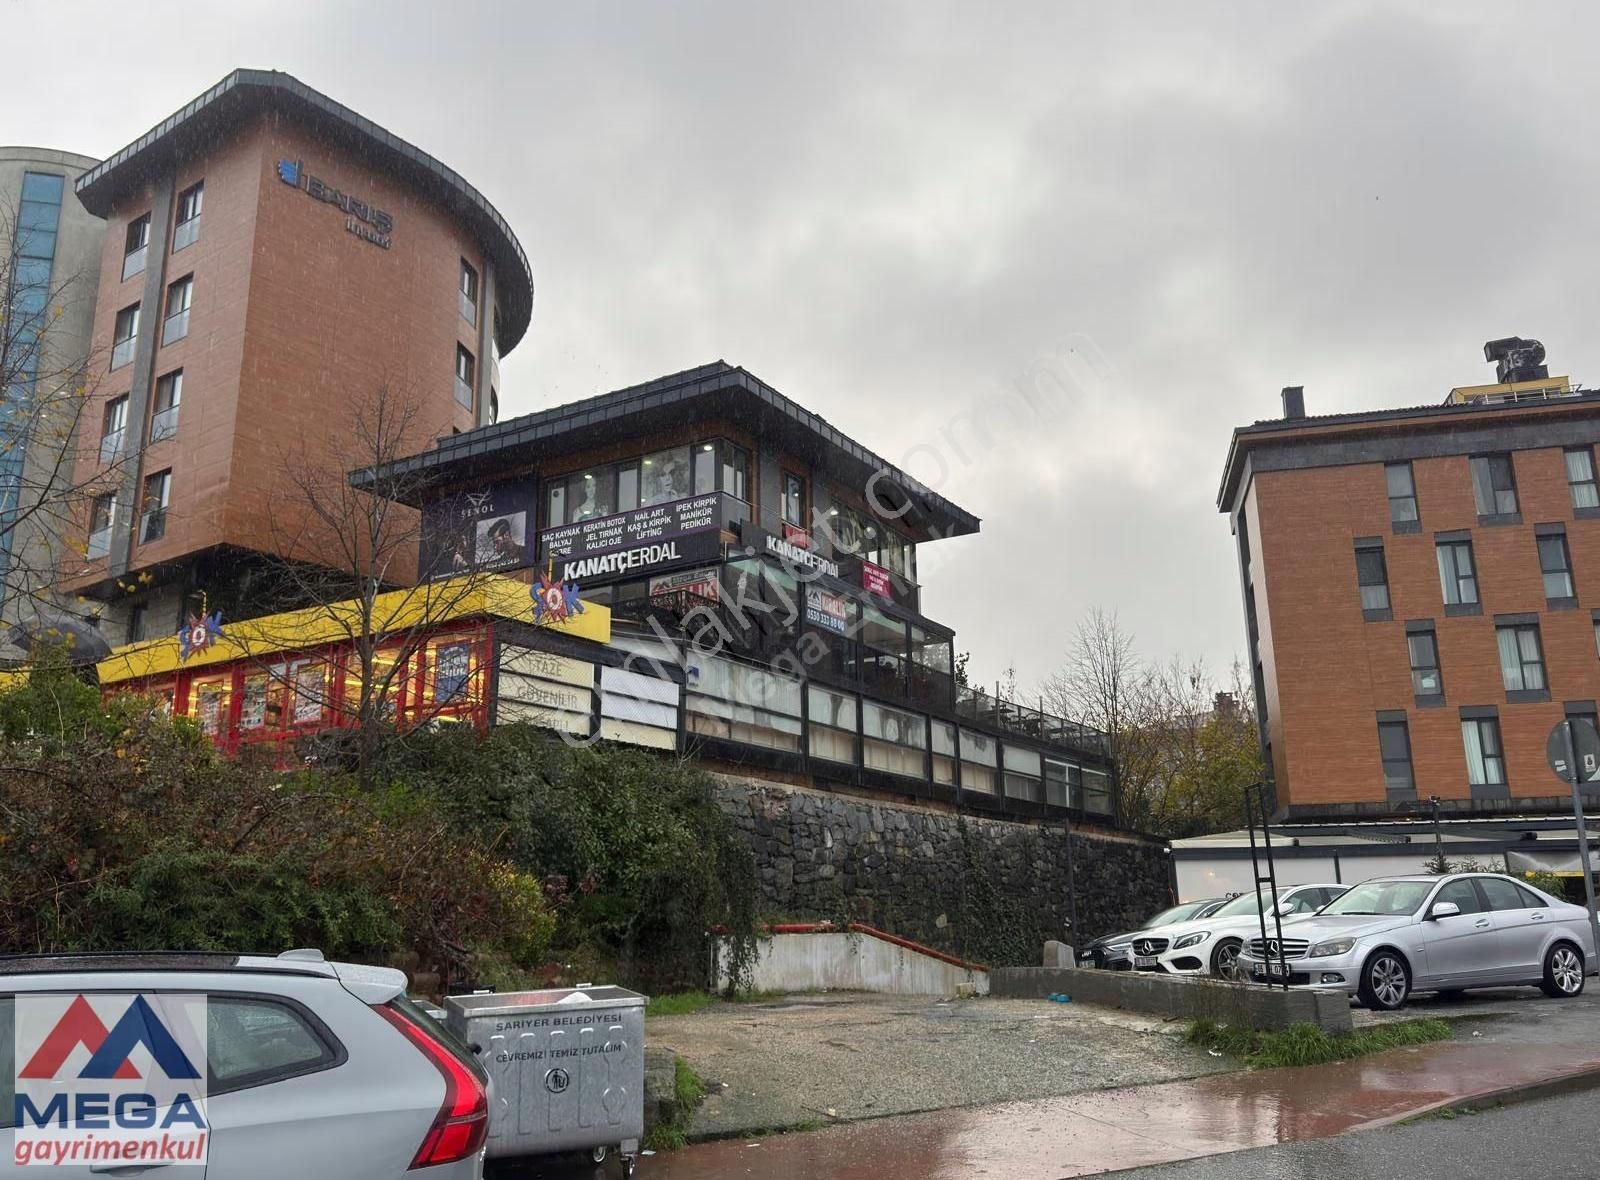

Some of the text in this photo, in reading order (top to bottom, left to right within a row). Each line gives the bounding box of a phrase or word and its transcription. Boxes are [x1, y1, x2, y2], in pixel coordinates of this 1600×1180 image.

[650, 508, 665, 517] ART
[680, 508, 712, 521] MANİKÜR
[606, 517, 626, 528] BOTOX
[627, 522, 642, 533] KAŞ
[642, 521, 648, 529] &
[680, 517, 712, 531] PEDİKÜR
[541, 526, 581, 542] SAÇ KAYNAK
[585, 526, 623, 542] JEL TIRNAK
[548, 538, 573, 549] BALYAJ
[586, 537, 622, 551] KALICI OJE
